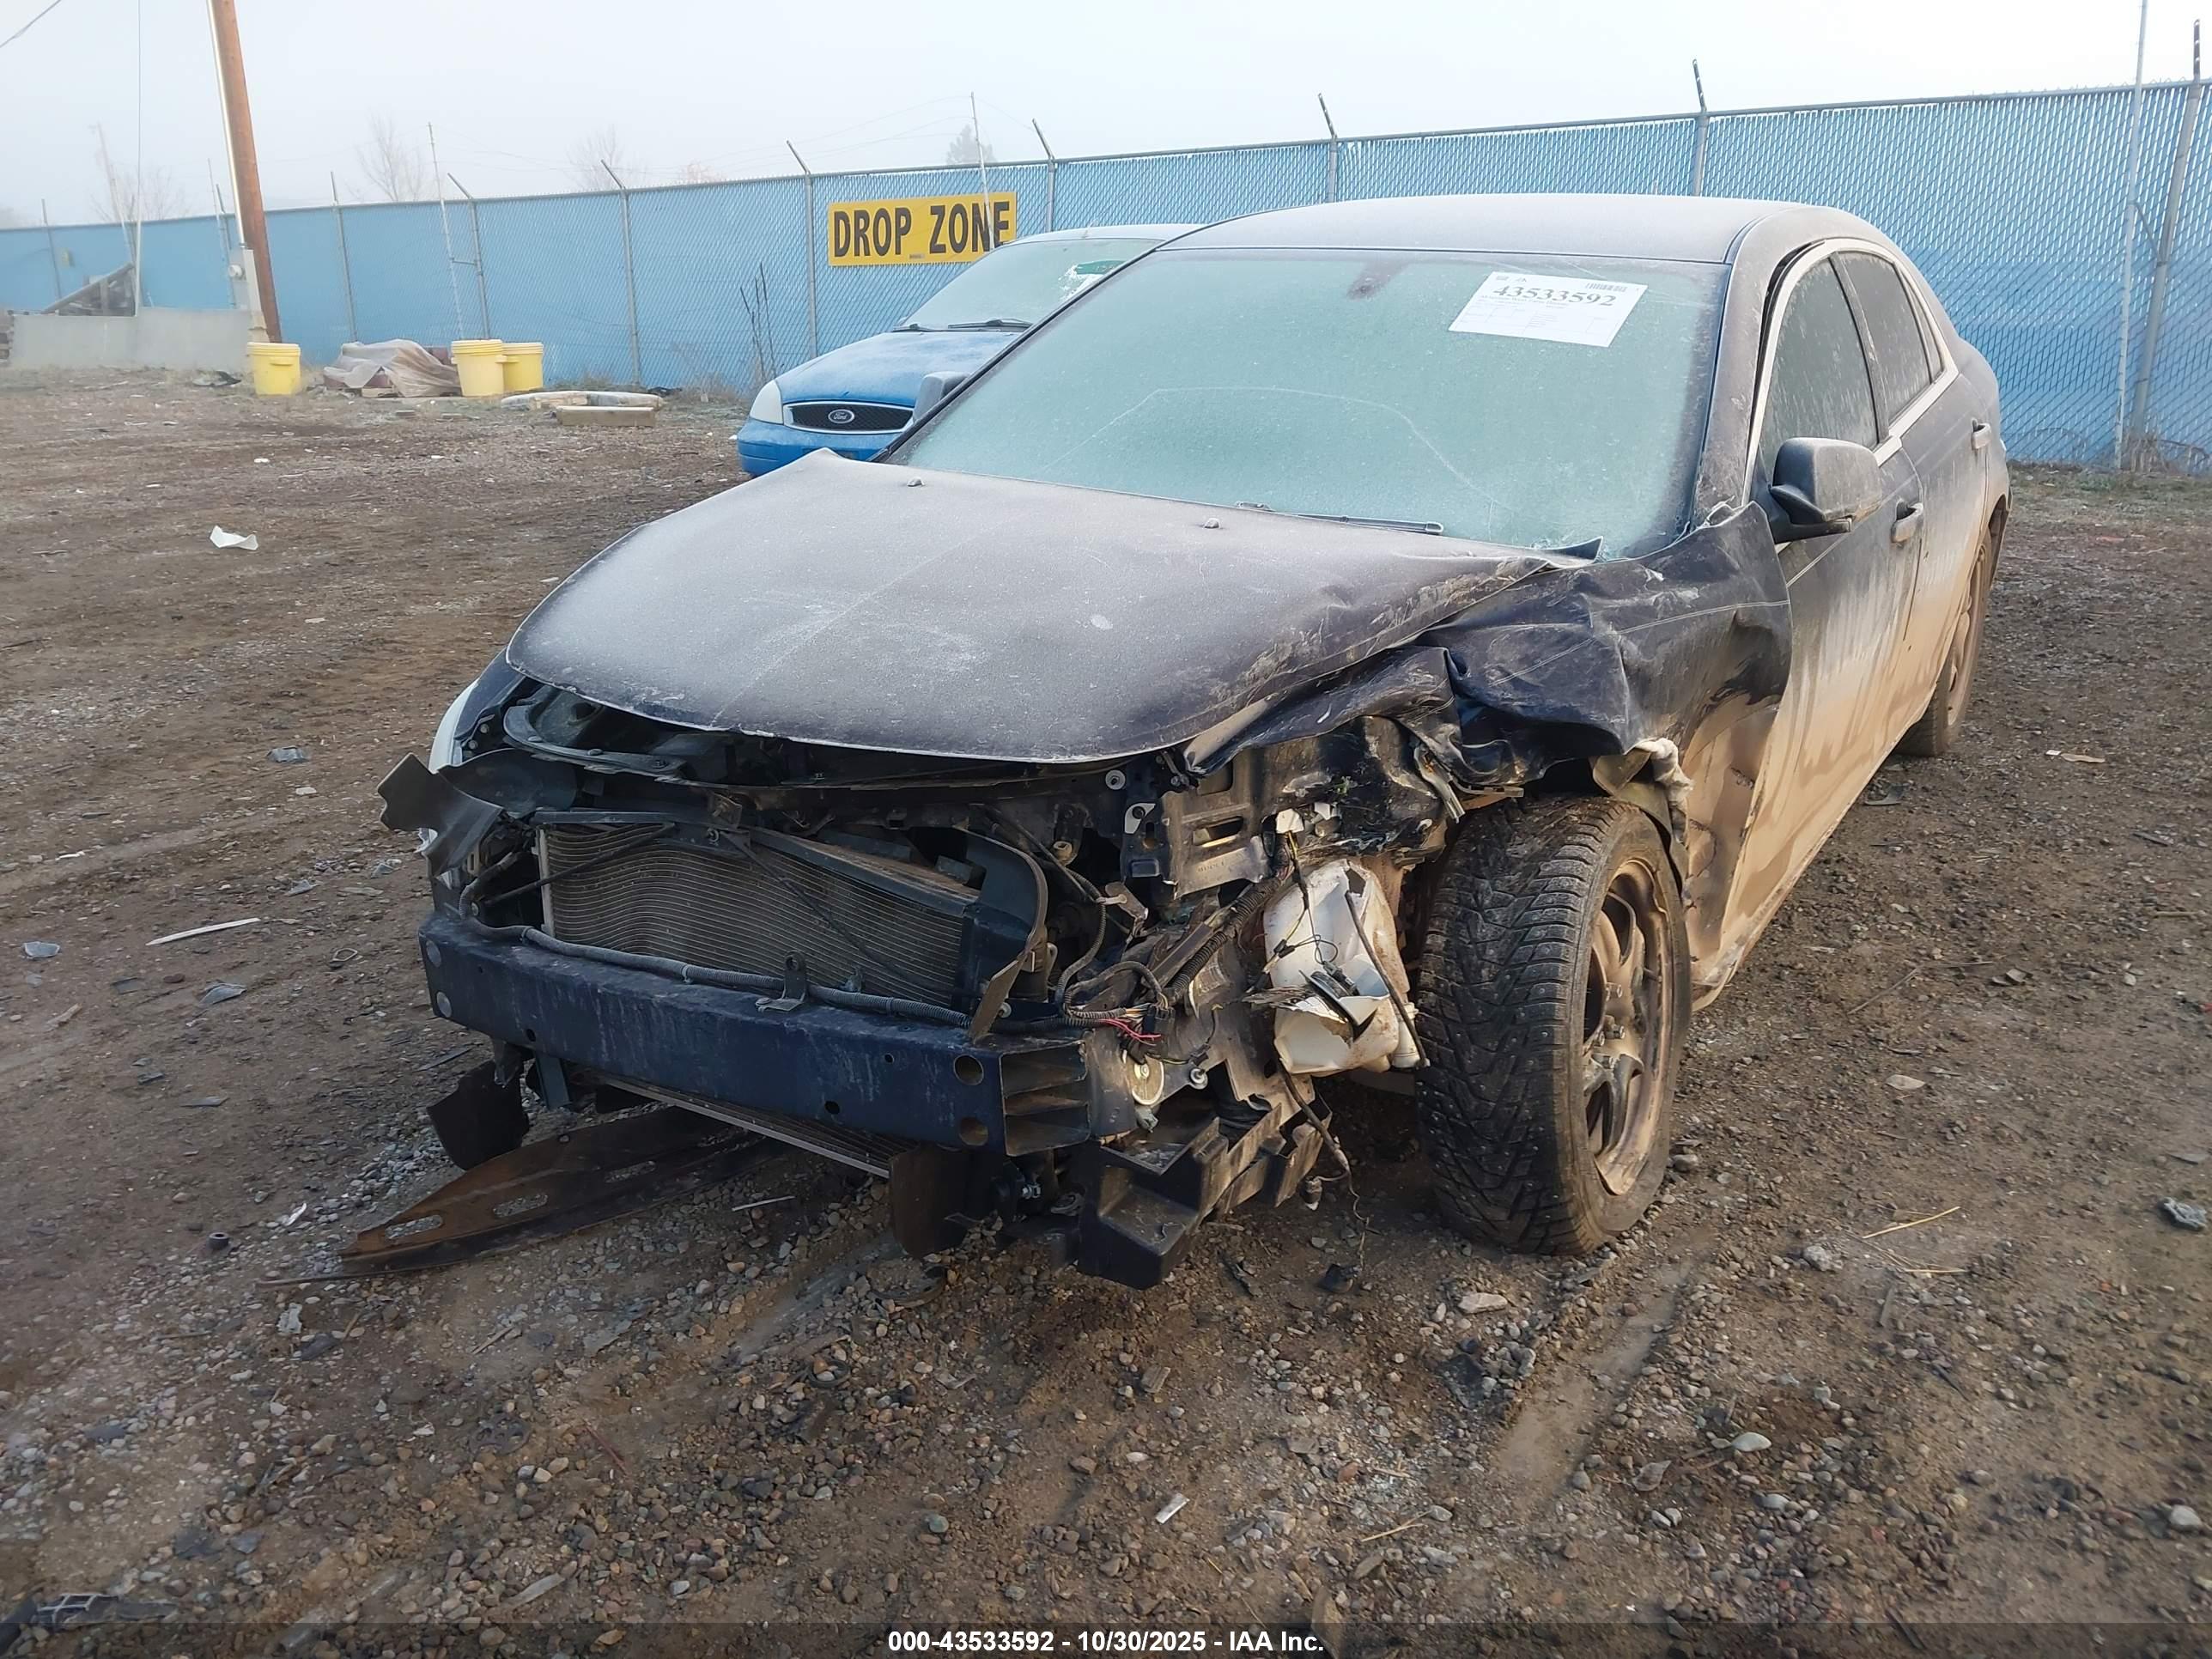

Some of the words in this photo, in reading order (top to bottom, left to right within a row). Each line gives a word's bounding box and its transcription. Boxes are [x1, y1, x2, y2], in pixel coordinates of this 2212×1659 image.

[834, 207, 912, 258] DROP
[929, 201, 1011, 254] ZONE
[1492, 284, 1618, 307] 43533592
